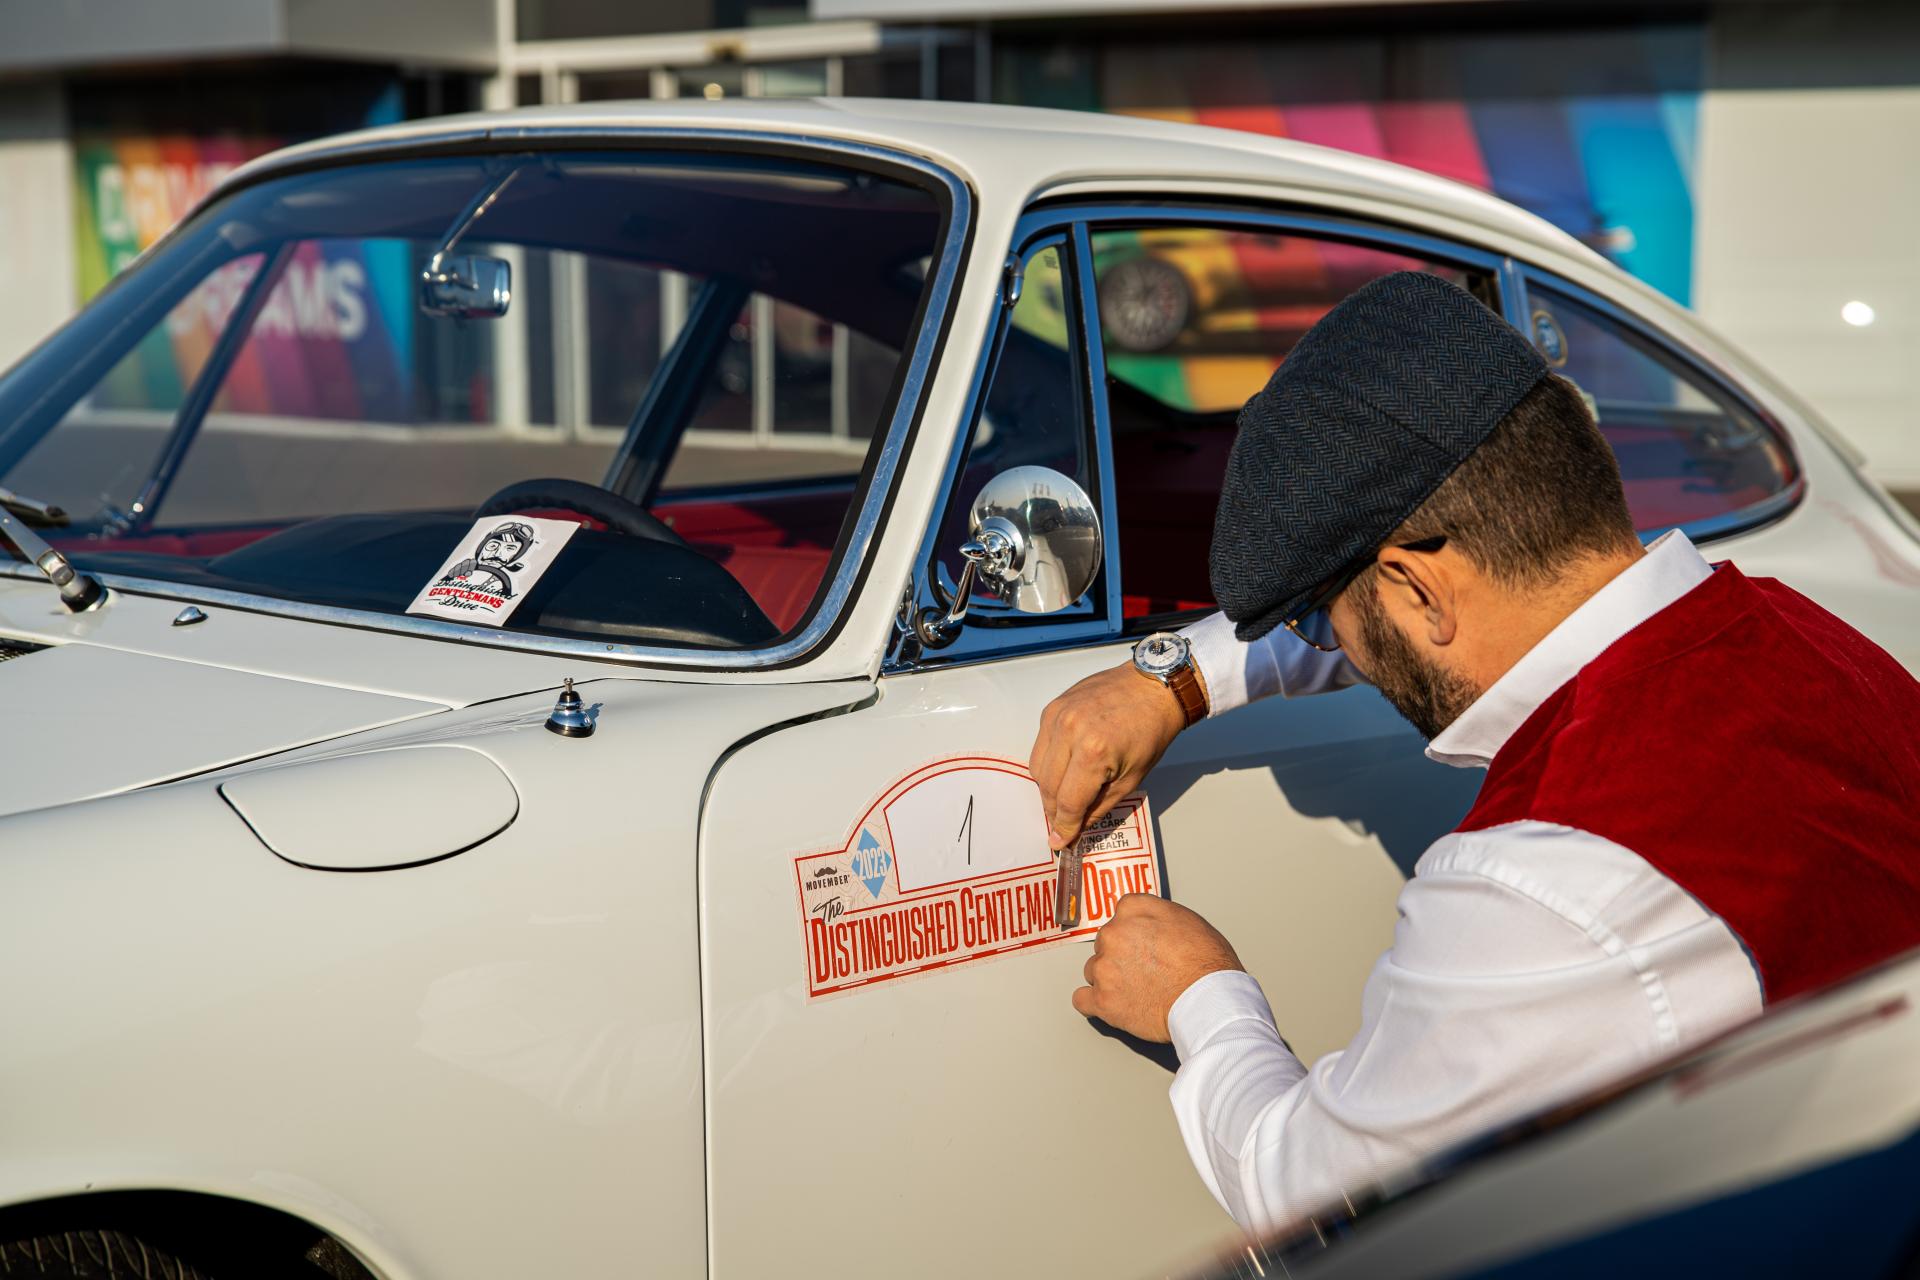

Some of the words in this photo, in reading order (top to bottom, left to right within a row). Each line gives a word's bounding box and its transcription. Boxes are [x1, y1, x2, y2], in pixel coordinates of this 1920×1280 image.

[428, 587, 505, 609] GENTLEMANS
[433, 580, 518, 600] Distinguished
[439, 595, 479, 610] Drive
[957, 794, 973, 866] 1
[1100, 818, 1127, 829] CARS
[1092, 839, 1129, 851] HEALTH
[1104, 831, 1124, 841] FOR
[854, 846, 888, 880] 2023
[805, 874, 850, 891] MOVEMBER
[812, 896, 845, 925] The
[811, 899, 959, 984] DISTINGUISHED
